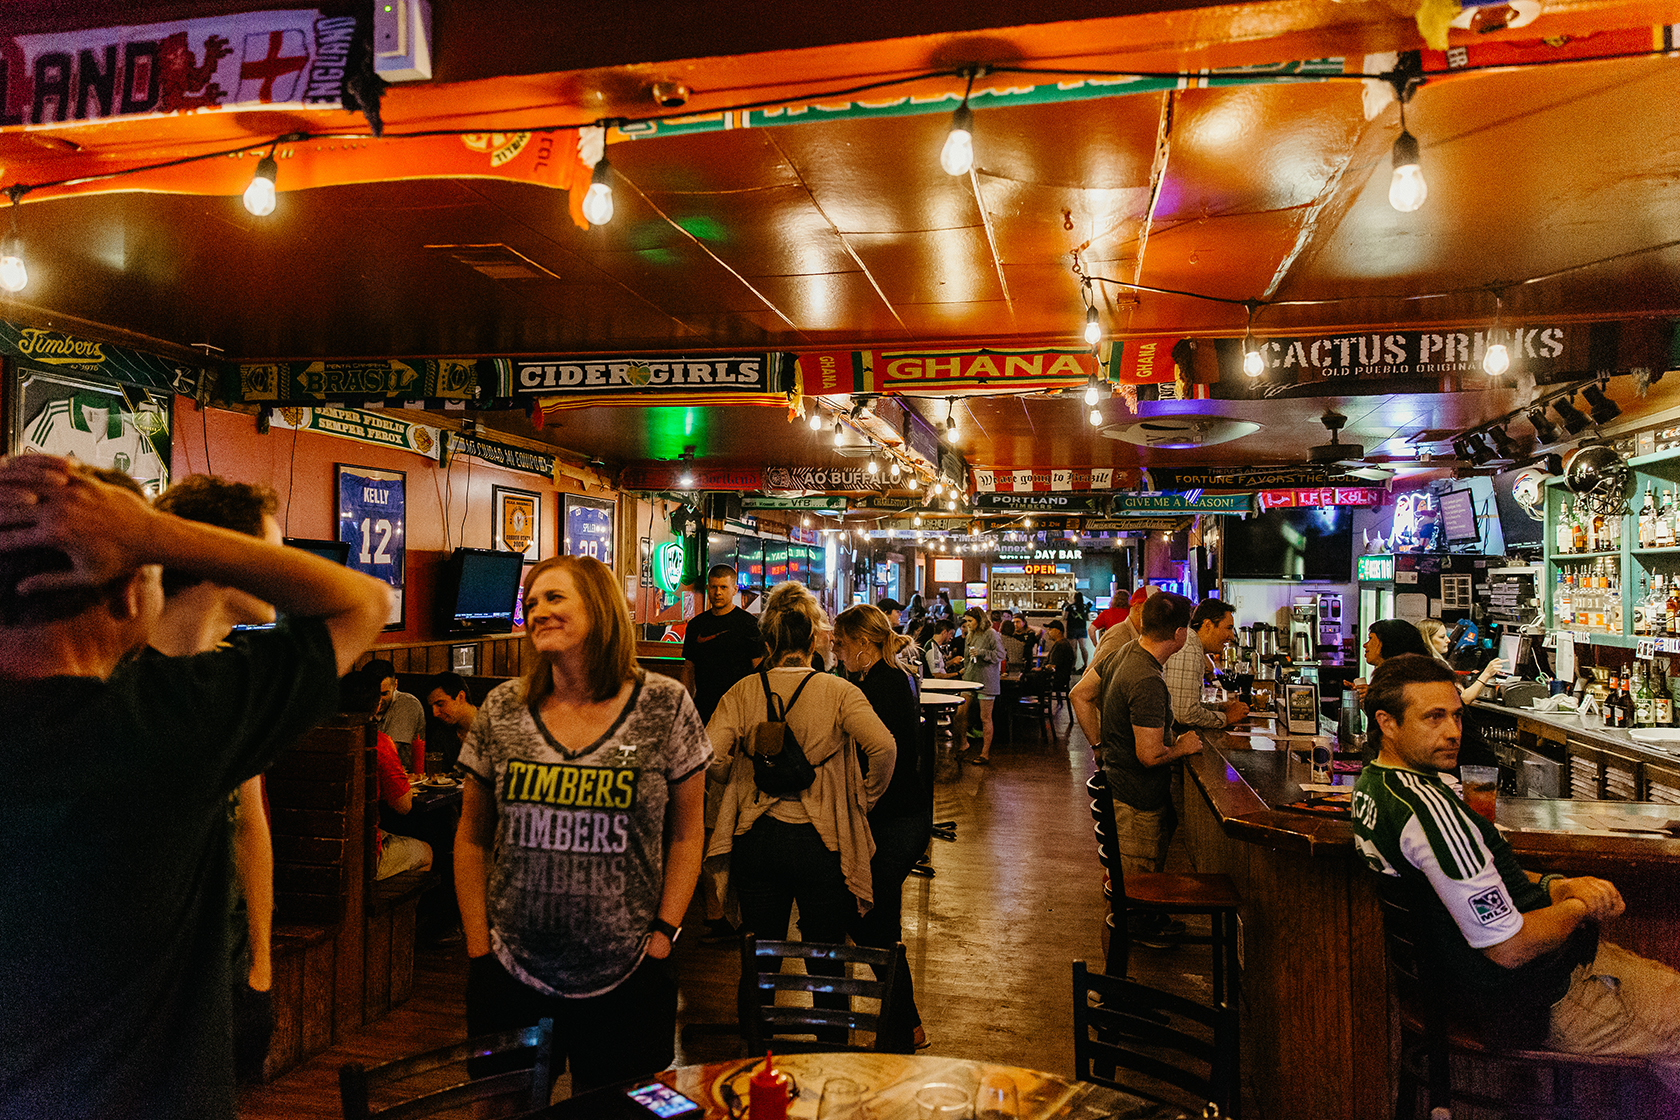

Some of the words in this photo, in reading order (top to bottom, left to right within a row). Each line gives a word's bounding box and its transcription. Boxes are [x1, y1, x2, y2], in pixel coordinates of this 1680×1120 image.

[18, 328, 104, 358] Timbers
[1261, 334, 1407, 368] CACTUS
[1419, 328, 1565, 363] PRIKS
[886, 355, 1084, 378] GHANA
[1136, 342, 1157, 378] GHANA
[303, 369, 412, 393] BRASIL
[520, 364, 634, 387] CIDER
[649, 362, 760, 384] GIRLS
[819, 355, 837, 389] GHANA
[1322, 367, 1350, 377] OLD
[1355, 365, 1409, 375] PUEBLO
[315, 407, 361, 423] SEMPER
[363, 415, 405, 433] FIDELIS
[319, 418, 365, 437] SEMPER
[367, 428, 403, 444] FEROX
[804, 472, 826, 485] AO
[831, 468, 901, 485] BUFFALO
[980, 474, 998, 486] We
[1000, 475, 1017, 484] are
[1020, 474, 1051, 485] going
[1053, 472, 1063, 482] to
[1066, 472, 1109, 485] Brazil!
[1175, 474, 1233, 485] FORTUNE
[1238, 473, 1295, 484] FAVORS
[1299, 473, 1323, 483] THE
[1328, 473, 1360, 483] BOLD
[364, 487, 389, 505] KELLY
[992, 495, 1068, 505] PORTLAND
[1008, 502, 1052, 510] TIMBERS
[1125, 498, 1150, 508] GIVE
[1153, 497, 1170, 508] ME
[1173, 498, 1181, 508] A
[1185, 497, 1234, 509] REASON!
[359, 518, 393, 564] 12
[993, 543, 1027, 552] Annex
[1002, 533, 1035, 542] ARMY
[1034, 550, 1056, 560] DAY
[1058, 550, 1082, 560] BAR
[1024, 564, 1056, 575] OPEN
[507, 761, 634, 809] TIMBERS
[505, 803, 629, 853] TIMBERS
[1481, 905, 1509, 923] MLS
